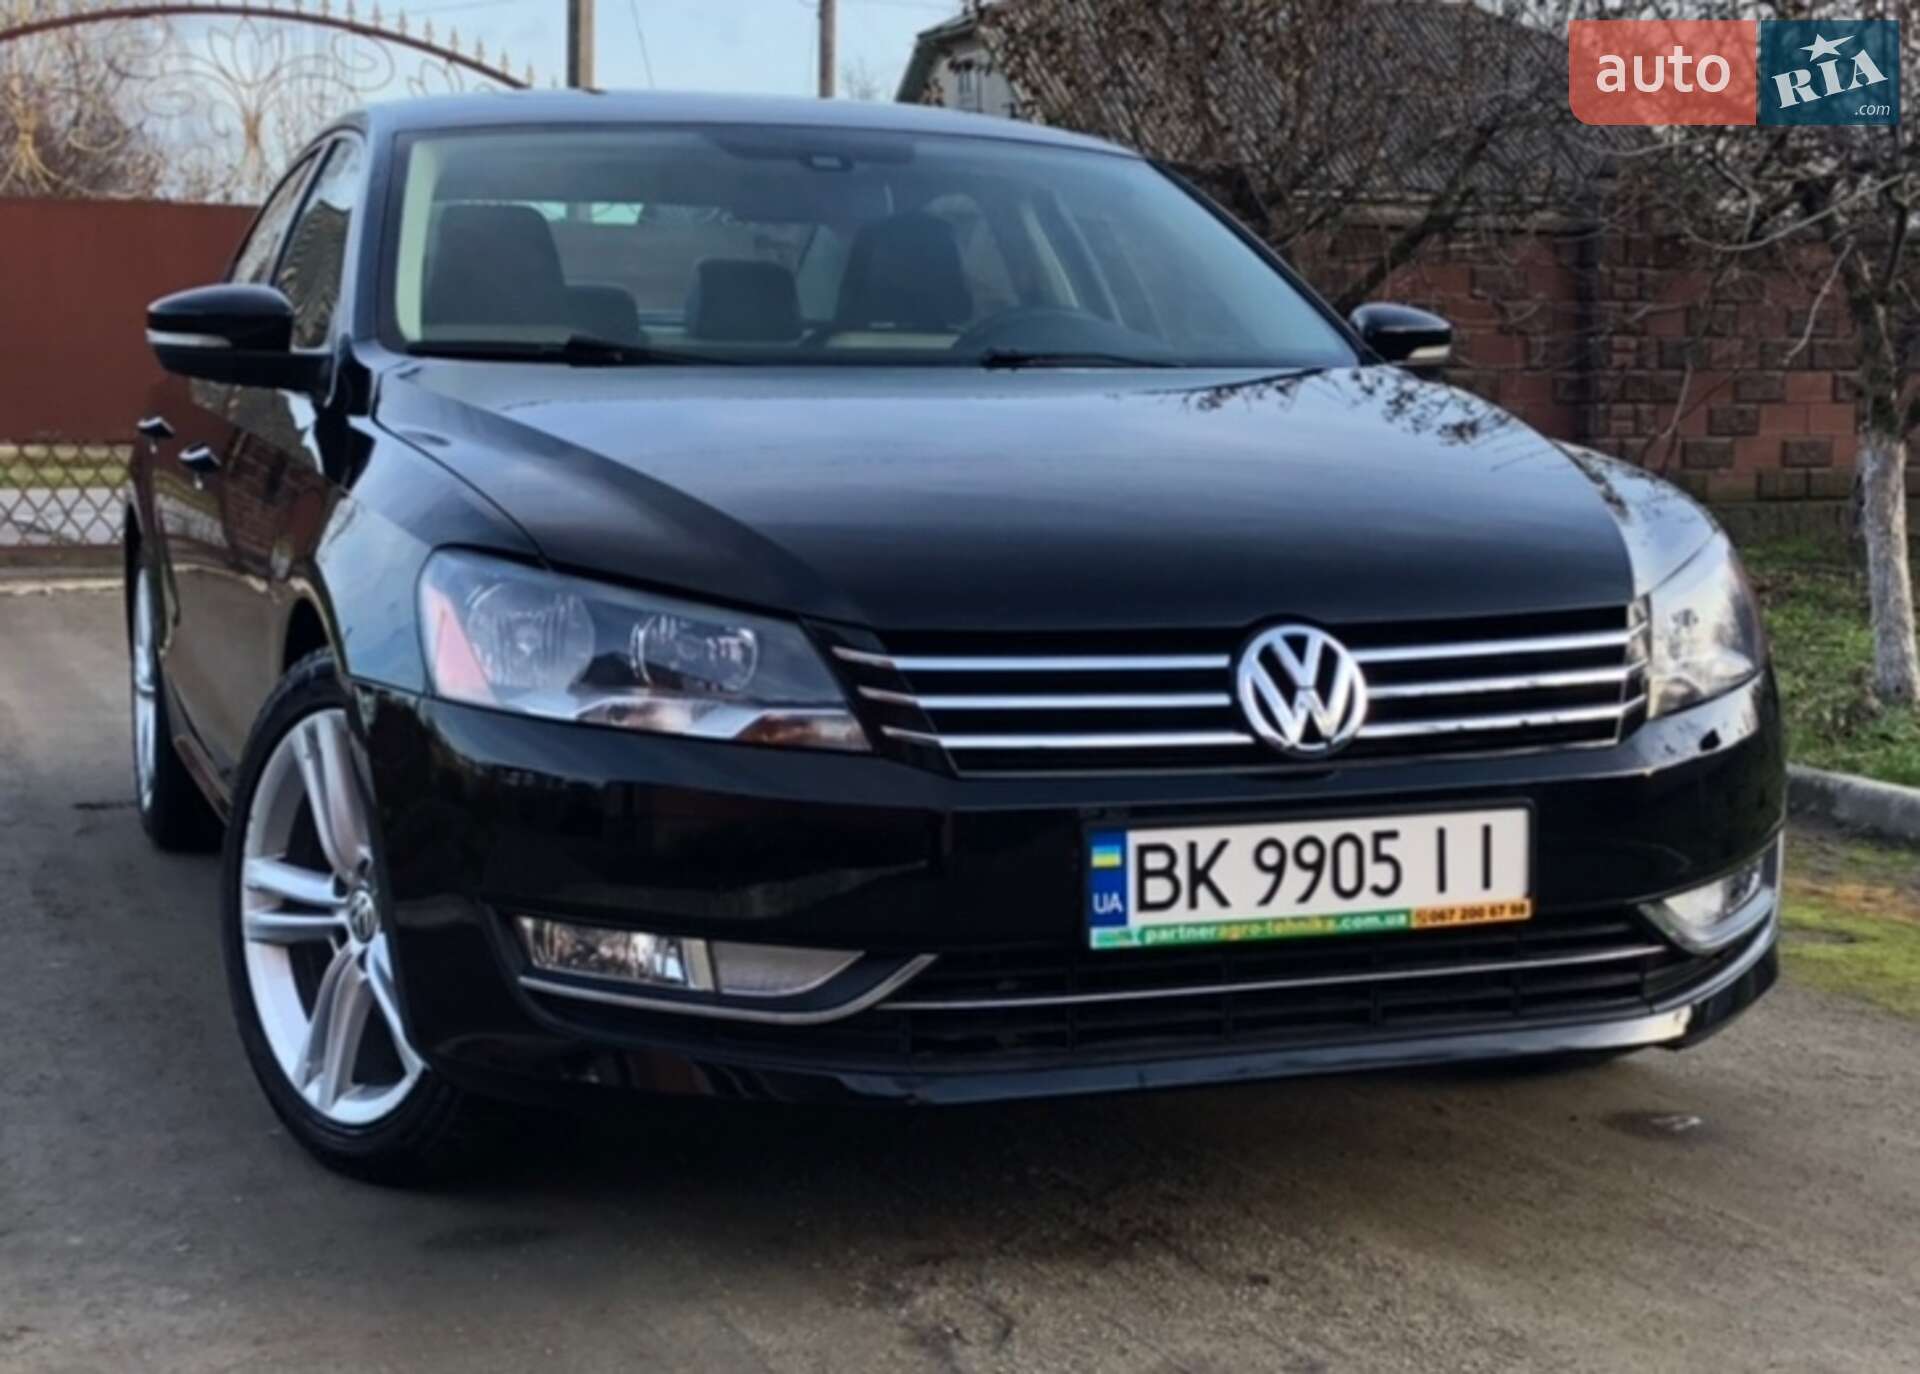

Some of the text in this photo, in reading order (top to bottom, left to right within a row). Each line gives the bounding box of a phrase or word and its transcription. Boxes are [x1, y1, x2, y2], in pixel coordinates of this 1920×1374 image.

[1136, 838, 1231, 913] BK
[1253, 829, 1401, 906] 9905
[1093, 893, 1122, 914] UA
